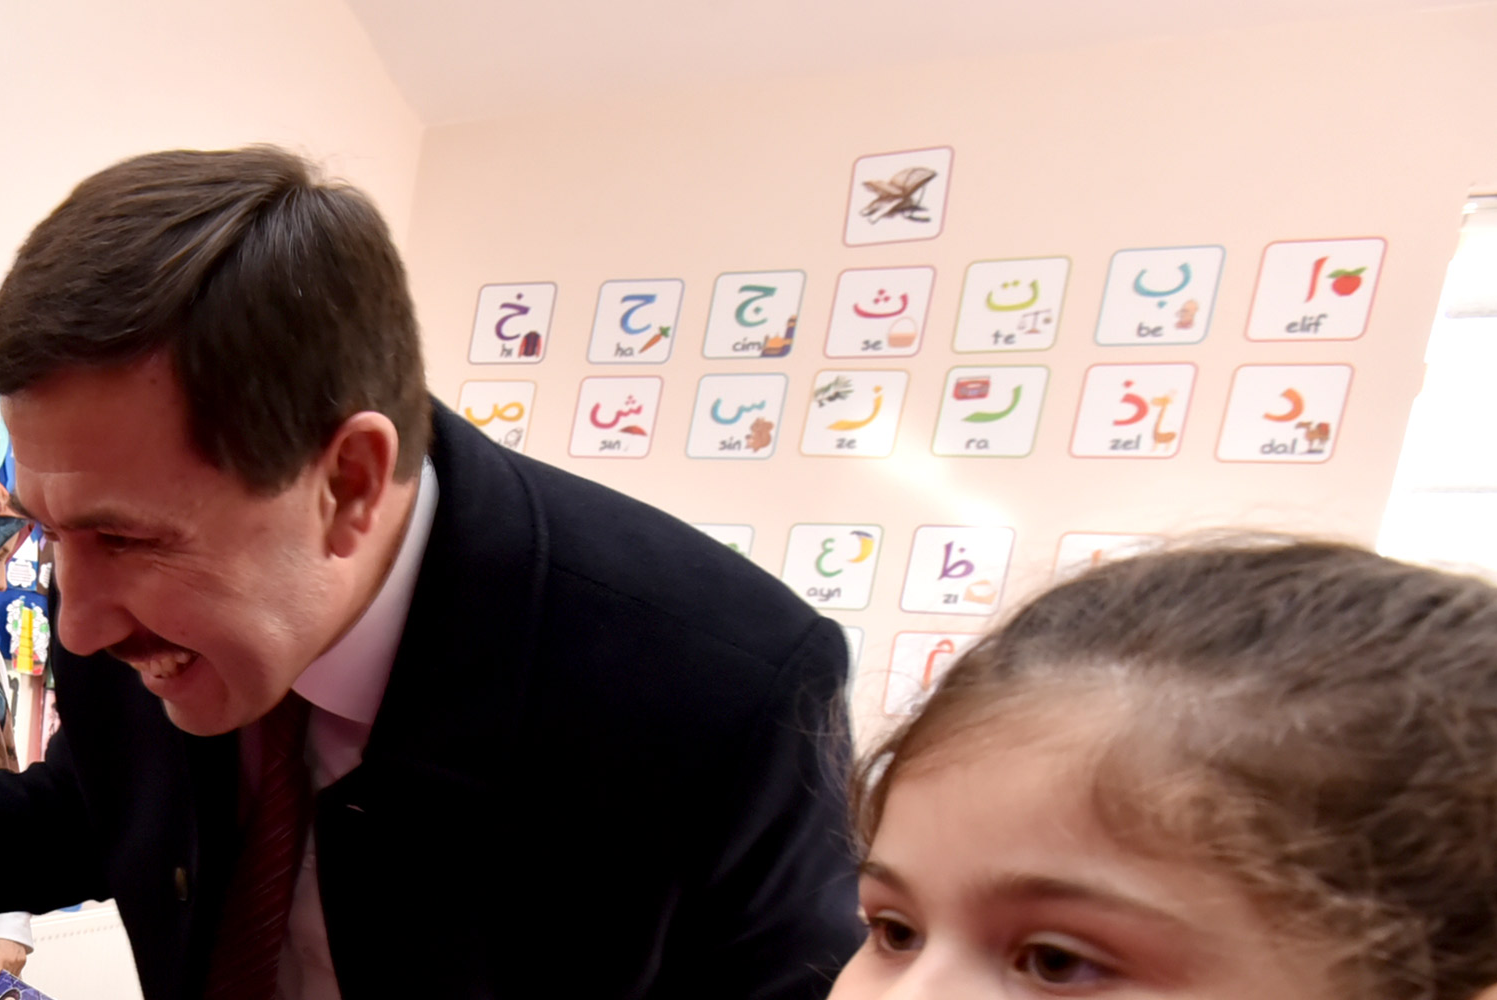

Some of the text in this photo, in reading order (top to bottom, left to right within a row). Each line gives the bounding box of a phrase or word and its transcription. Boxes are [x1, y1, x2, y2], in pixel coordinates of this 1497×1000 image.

[985, 279, 1040, 312] ت
[1132, 262, 1193, 309] ب
[494, 292, 531, 341] خ
[620, 293, 658, 335] ح
[734, 284, 778, 328] ج
[853, 288, 909, 319] ث
[991, 330, 1017, 345] te
[1136, 321, 1165, 338] be
[1284, 313, 1329, 334] elif
[613, 341, 635, 358] ha
[732, 336, 764, 353] cim
[860, 338, 883, 352] se
[464, 401, 526, 427] ص
[590, 394, 644, 430] ش
[710, 397, 767, 425] س
[825, 384, 884, 432] ز
[961, 384, 1023, 424] ر
[1112, 379, 1149, 427] ذ
[1262, 387, 1305, 423] د
[717, 435, 743, 451] sin
[834, 437, 858, 450] ze
[964, 436, 991, 451] ra
[1108, 433, 1143, 451] zel
[1259, 438, 1299, 456] dal
[814, 537, 844, 578] ع
[937, 541, 976, 581] ظ
[805, 586, 842, 603] ayn
